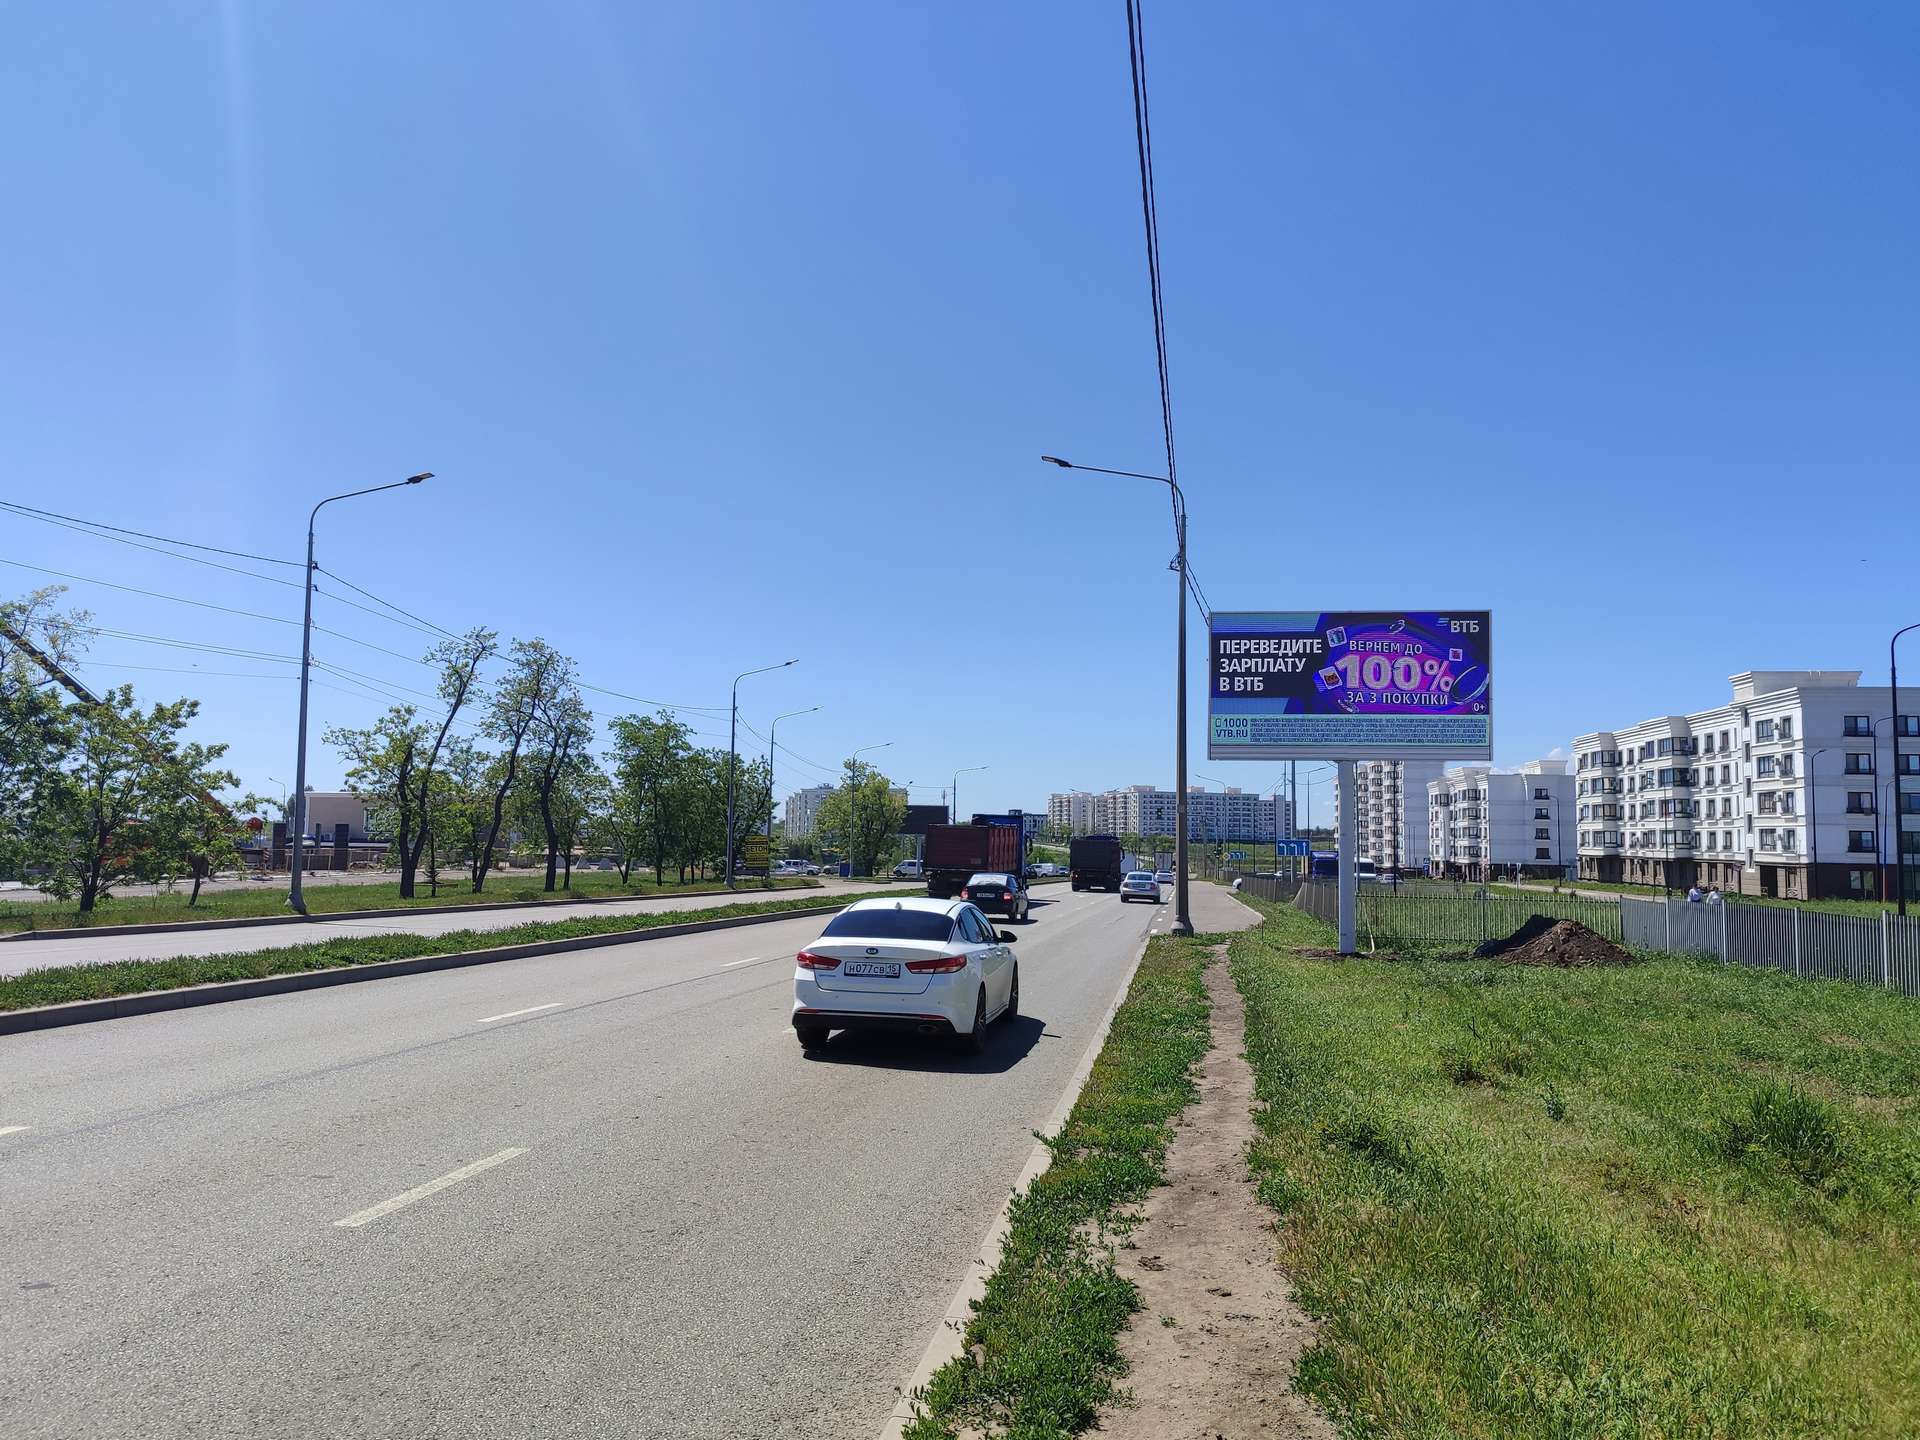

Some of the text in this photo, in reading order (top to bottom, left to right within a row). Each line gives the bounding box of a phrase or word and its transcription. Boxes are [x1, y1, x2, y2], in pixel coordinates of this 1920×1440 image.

[1450, 620, 1480, 633] ВТБ
[1219, 639, 1322, 656] ПЕРЕВЕДИТЕ
[1349, 640, 1423, 655] ВЕРНЕМ ДО
[1219, 658, 1307, 673] ЗАРПЛАТУ
[1334, 654, 1453, 692] 100%
[1219, 677, 1264, 692] В ВТБ
[1346, 691, 1448, 705] ЗА 3 ПОКУПКИ
[1473, 702, 1485, 712] 0+
[1223, 718, 1248, 728] 1000
[1215, 729, 1248, 738] VTB.RU
